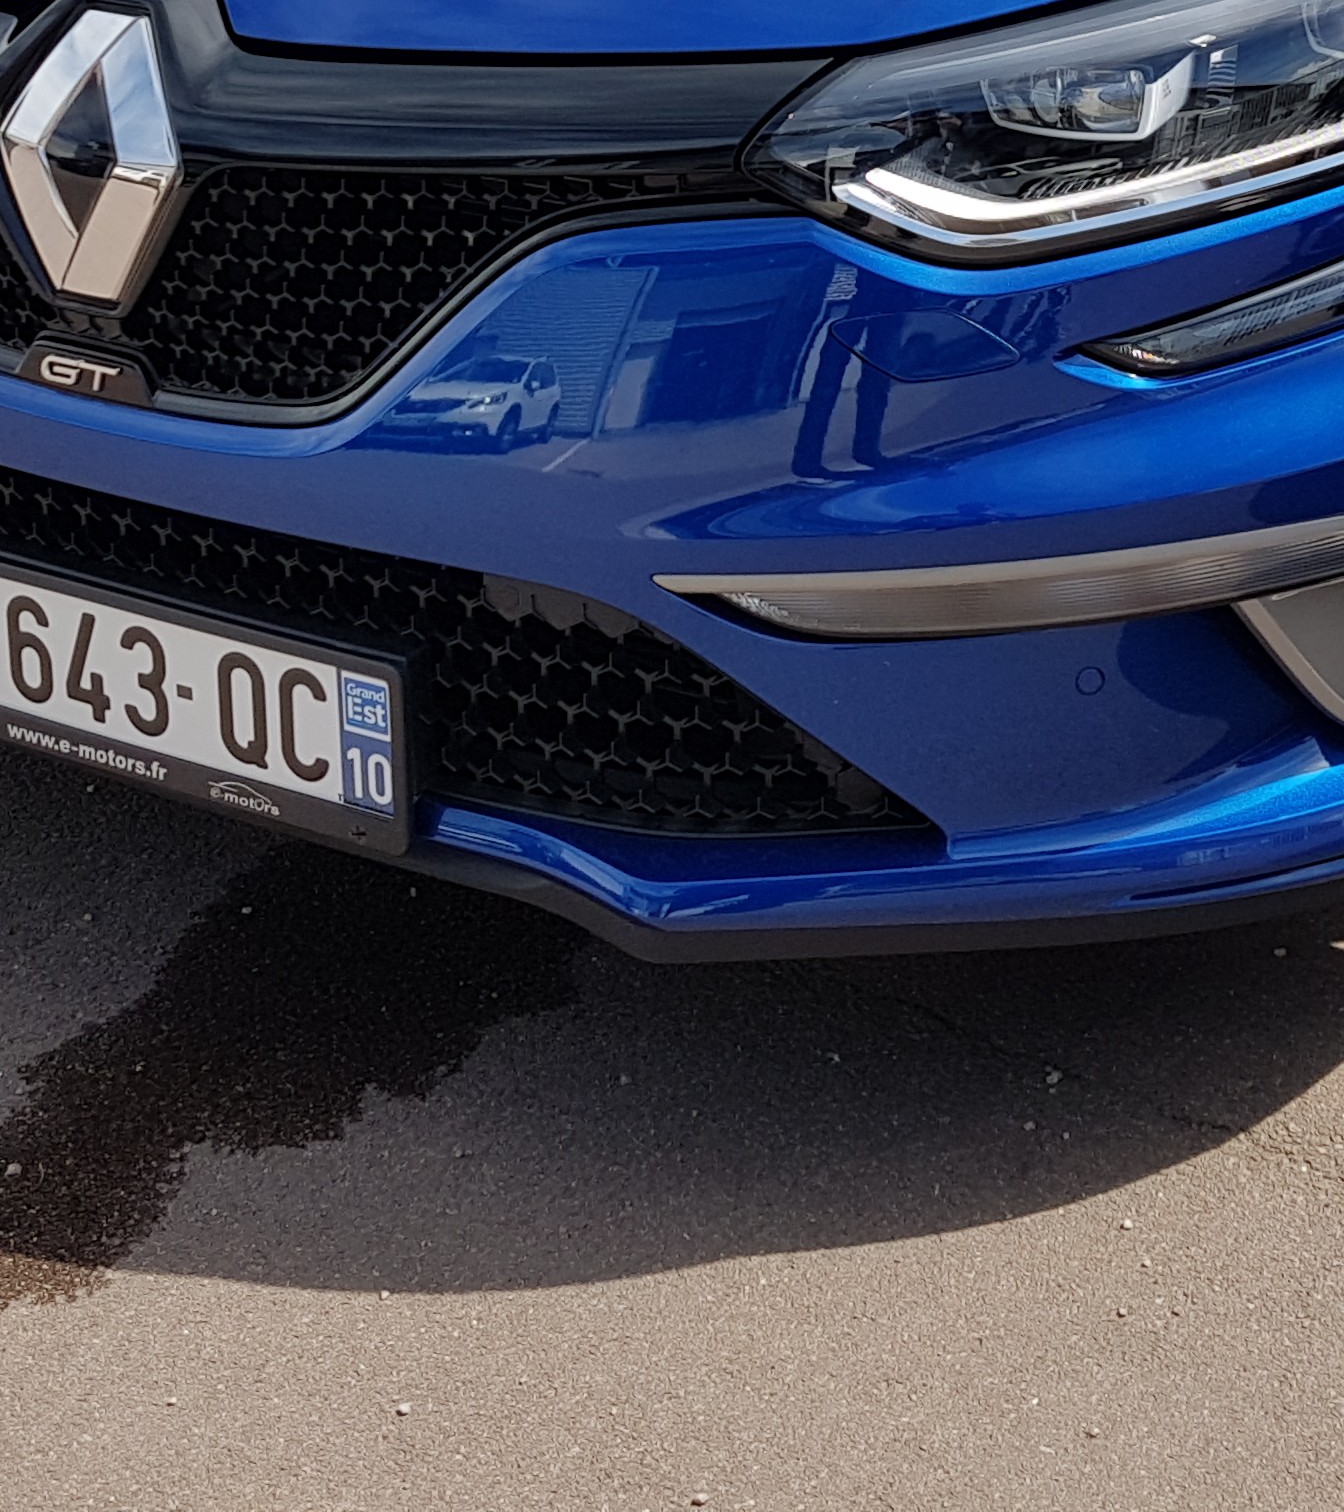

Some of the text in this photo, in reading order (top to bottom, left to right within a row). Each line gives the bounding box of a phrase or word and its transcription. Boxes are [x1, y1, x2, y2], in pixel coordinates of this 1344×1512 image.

[40, 355, 120, 391] GT
[347, 683, 385, 703] Grand
[347, 696, 386, 728] Est
[7, 723, 167, 781] www.e-motors.fr
[347, 747, 393, 805] 10
